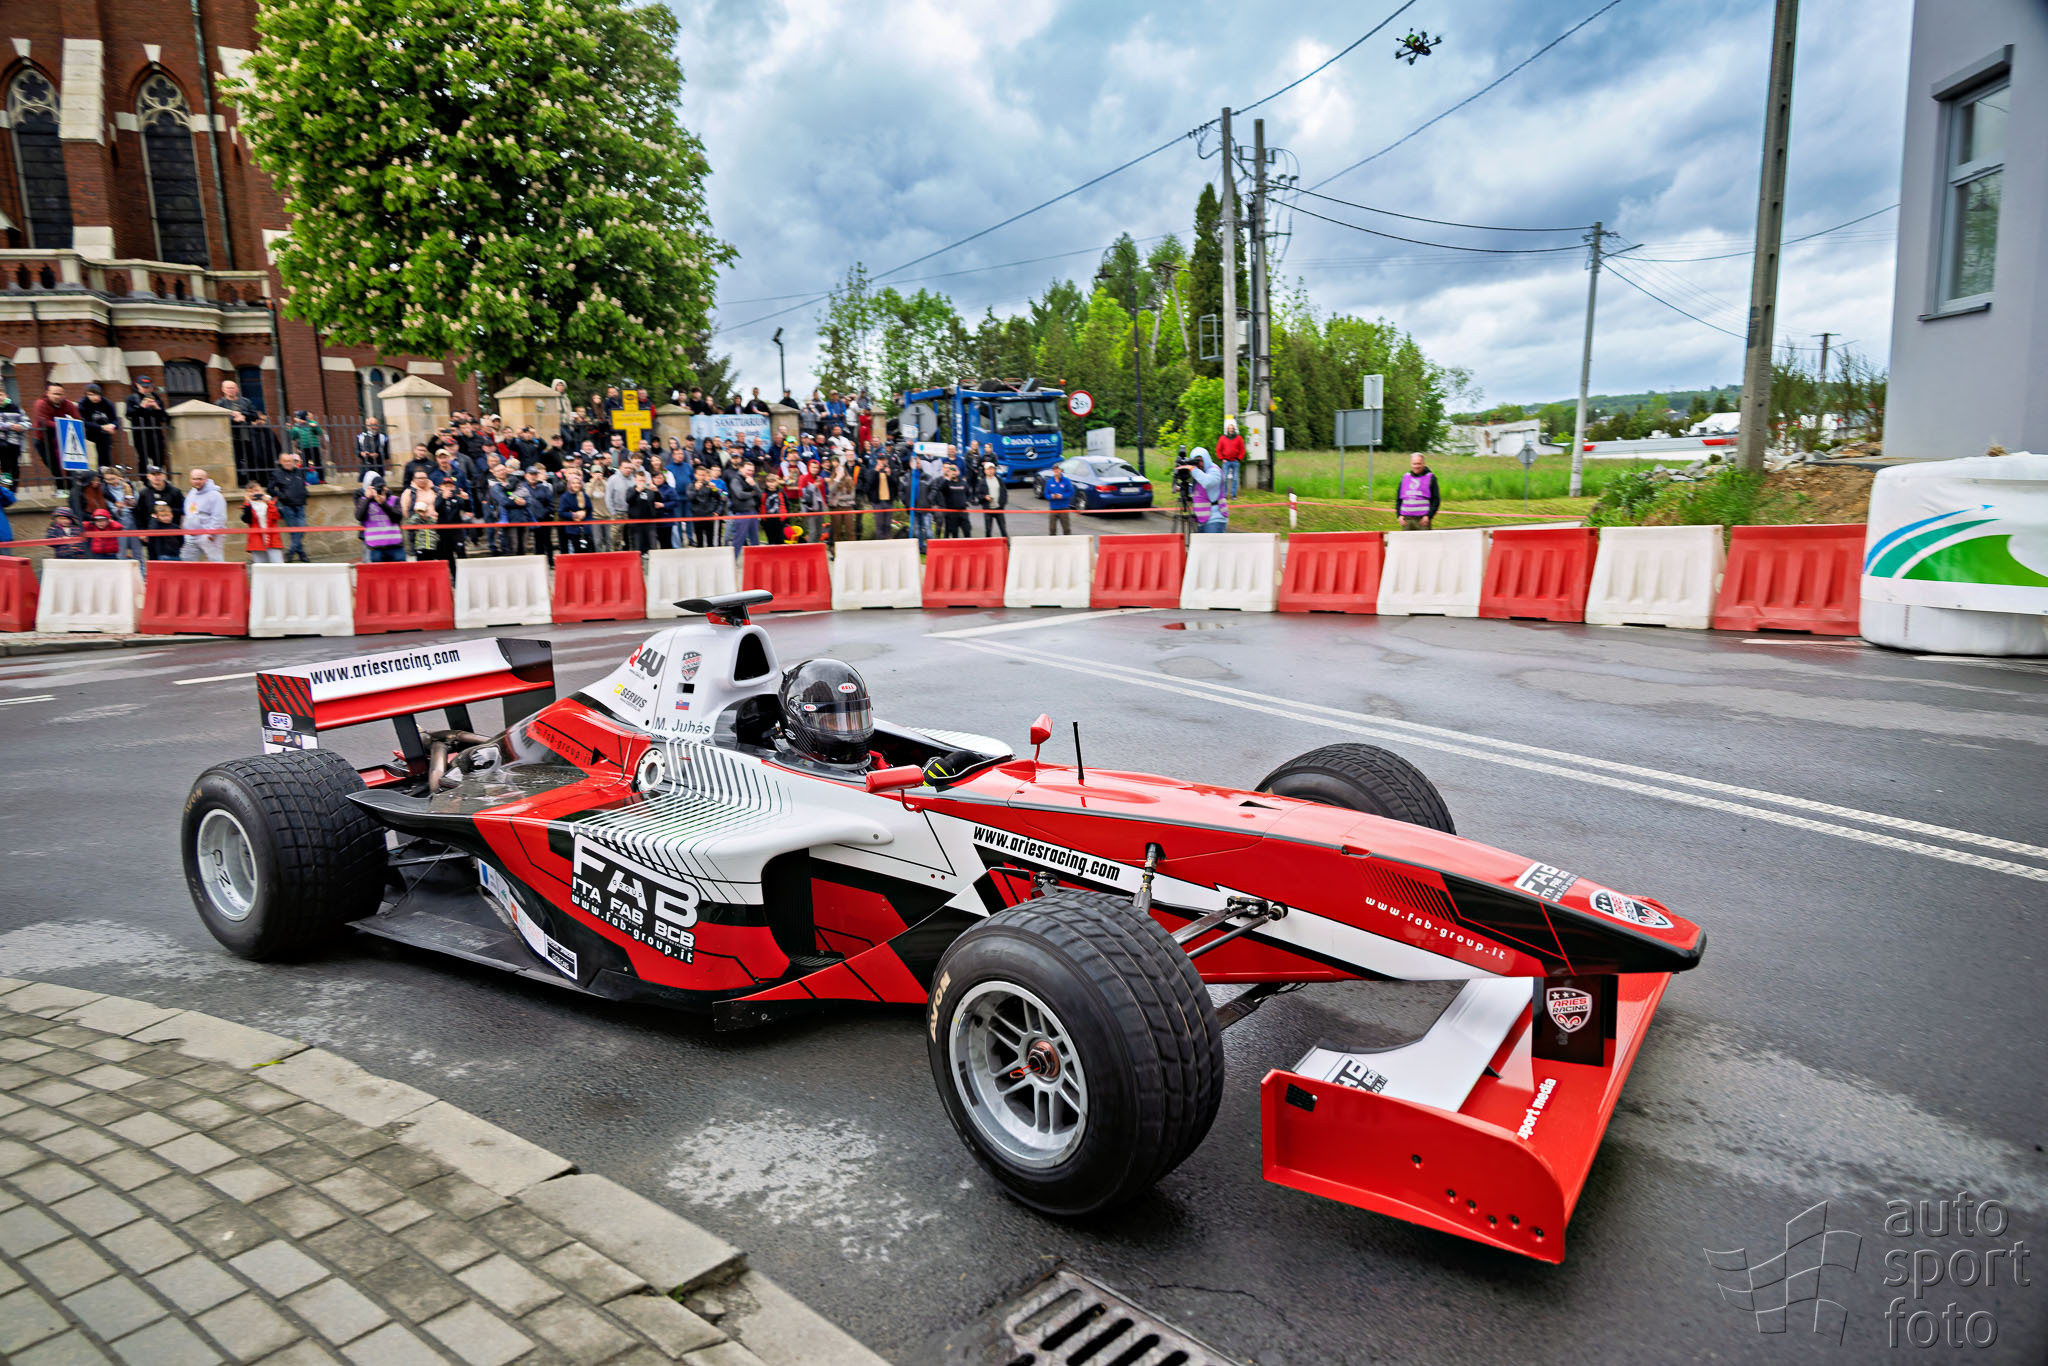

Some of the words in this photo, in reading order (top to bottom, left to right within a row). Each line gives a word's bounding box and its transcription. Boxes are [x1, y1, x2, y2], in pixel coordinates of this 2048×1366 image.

[310, 649, 461, 685] www.ariesracing.com
[620, 687, 648, 709] SERVIS
[654, 717, 667, 731] M.
[671, 718, 711, 734] Juhás
[973, 825, 1121, 881] www.ariesracing.com
[573, 833, 700, 928] FAB
[612, 879, 643, 899] GROUP
[571, 894, 694, 963] www.fab-group.it
[572, 876, 602, 904] ITA
[610, 897, 644, 925] FAB
[655, 919, 695, 948] BCB
[1365, 896, 1506, 960] www.fab-group.it
[1552, 1004, 1588, 1013] RACING
[1553, 997, 1587, 1007] ARIES
[1517, 1108, 1541, 1140] sport
[1532, 1078, 1557, 1109] media
